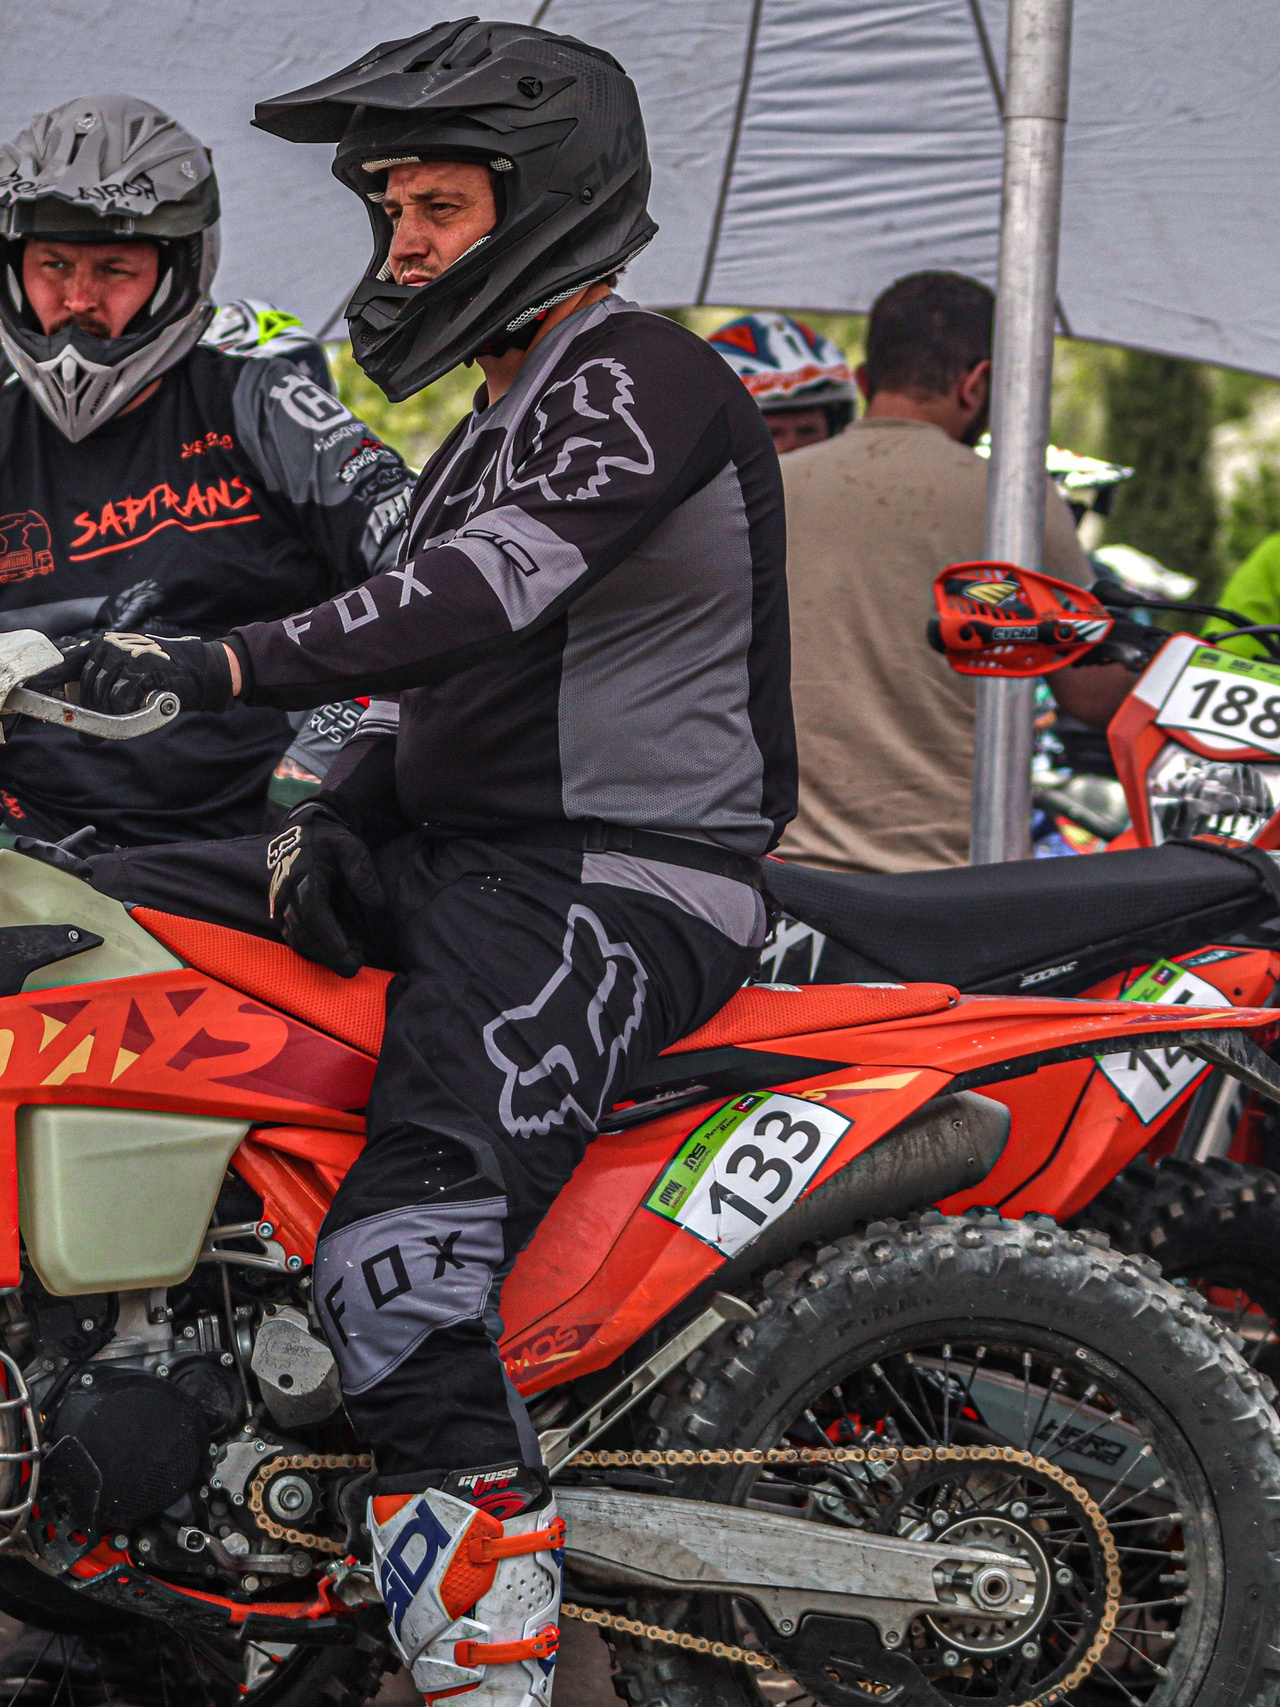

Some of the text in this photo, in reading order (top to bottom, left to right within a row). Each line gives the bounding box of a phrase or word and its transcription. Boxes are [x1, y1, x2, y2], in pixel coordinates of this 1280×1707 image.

[71, 475, 253, 547] SAPTRANS
[282, 561, 432, 645] FOX
[308, 713, 346, 744] RUS
[1189, 678, 1280, 740] 188
[672, 1186, 688, 1209] ENDURO
[708, 1110, 822, 1227] 133
[322, 1229, 463, 1347] FOX
[457, 1466, 519, 1488] cross
